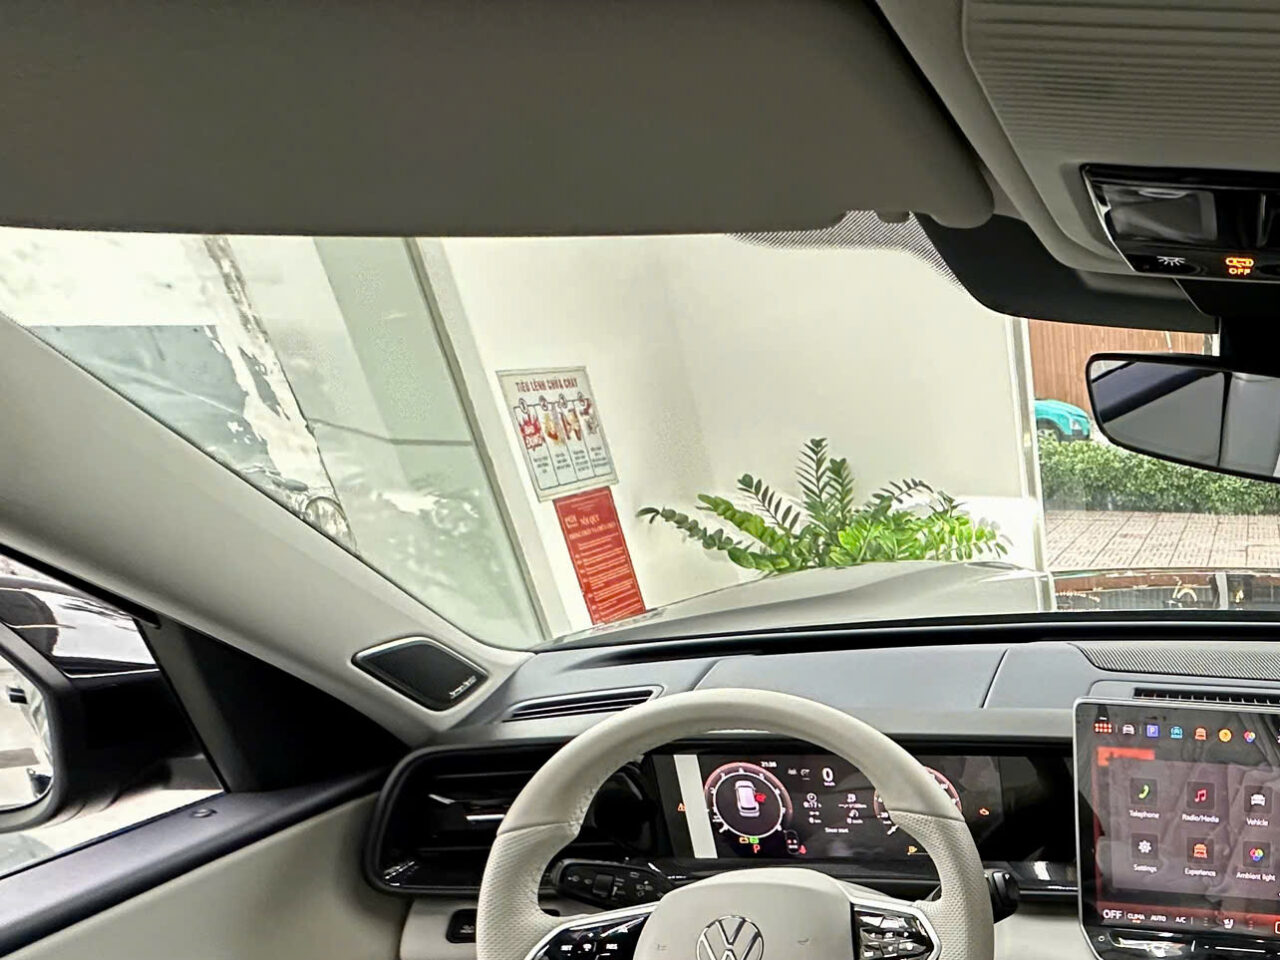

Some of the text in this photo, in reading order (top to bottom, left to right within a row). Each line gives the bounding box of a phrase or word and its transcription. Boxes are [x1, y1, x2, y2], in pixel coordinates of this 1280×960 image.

[1229, 267, 1251, 276] OFF
[822, 767, 834, 782] 0
[1129, 809, 1160, 819] Telephone
[1182, 813, 1219, 824] Radio/Media
[1246, 817, 1269, 827] Vehicle
[1133, 864, 1157, 874] Settings
[1184, 868, 1216, 878] Experience
[1236, 871, 1276, 882] Ambient light
[1103, 909, 1122, 919] OFF
[1150, 914, 1167, 922] AUTO
